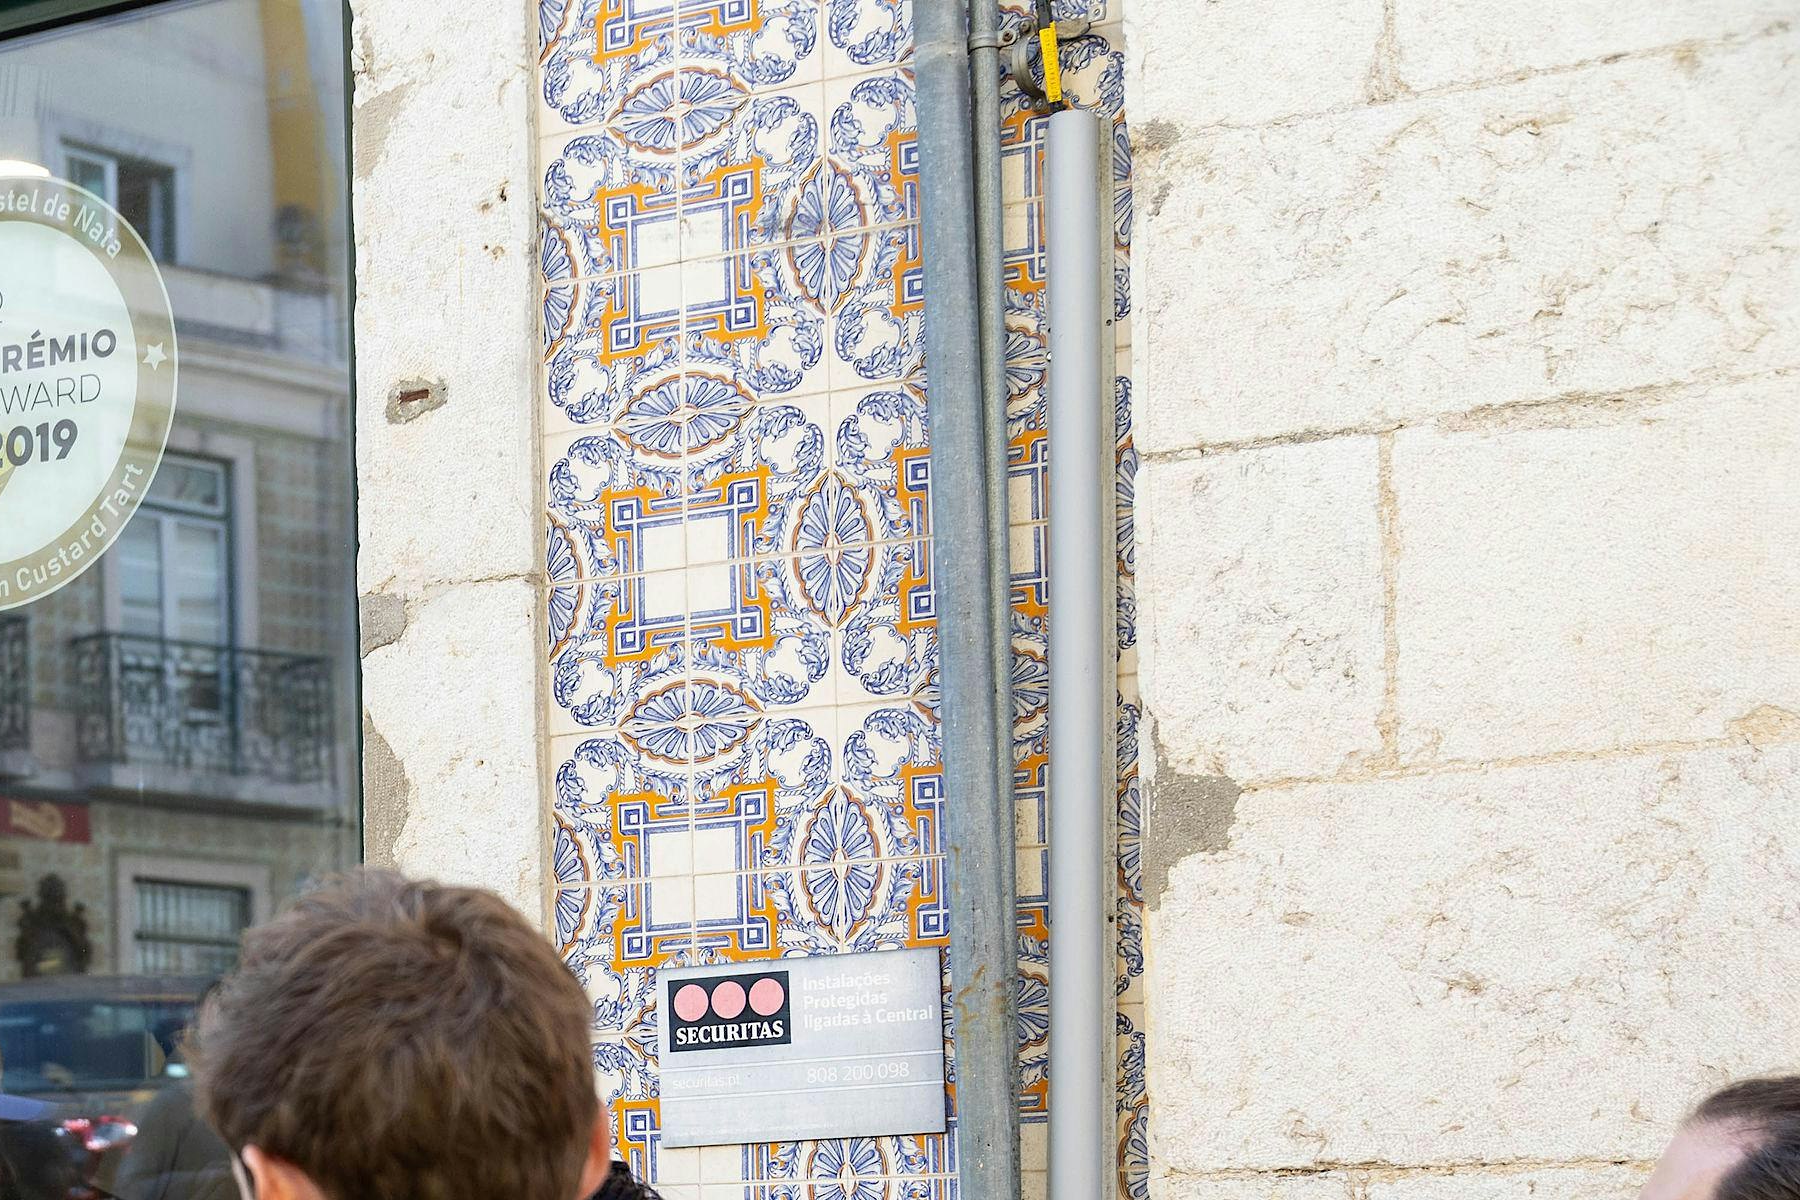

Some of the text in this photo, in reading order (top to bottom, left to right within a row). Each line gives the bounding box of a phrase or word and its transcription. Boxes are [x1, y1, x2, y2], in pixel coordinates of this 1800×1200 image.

[42, 193, 70, 221] de
[72, 204, 122, 260] Nata
[15, 514, 107, 592] Custard
[99, 462, 144, 518] Tart
[803, 971, 890, 990] Instalações
[803, 991, 888, 1010] Protegidas
[862, 1009, 872, 1024] à
[876, 1005, 933, 1022] Central
[676, 1020, 784, 1046] SECURITAS
[807, 1062, 910, 1084] 808 200 098
